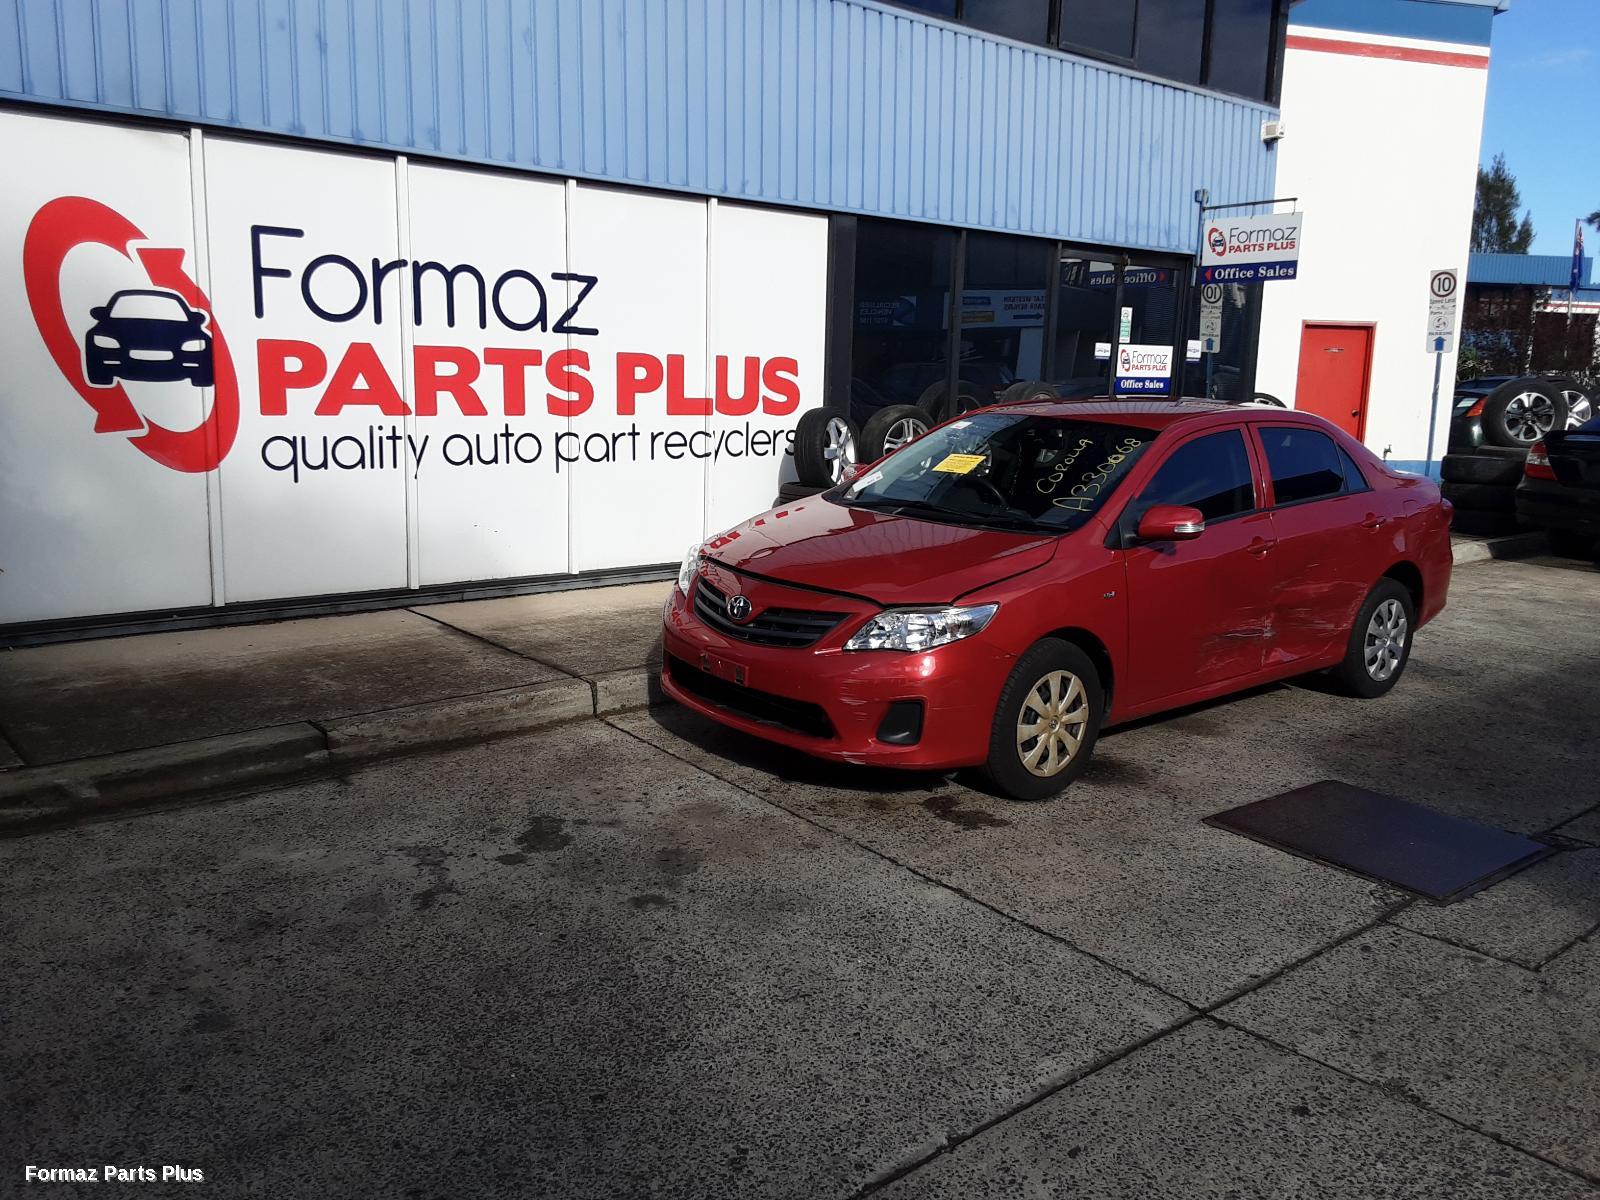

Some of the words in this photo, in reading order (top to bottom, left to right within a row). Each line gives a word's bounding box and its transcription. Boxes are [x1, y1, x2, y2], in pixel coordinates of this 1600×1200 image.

[1229, 227, 1297, 244] Formaz
[1228, 243, 1264, 253] PARTS
[1267, 241, 1296, 251] PLUS
[1215, 267, 1253, 279] Office
[1258, 265, 1294, 277] Sales
[251, 225, 599, 335] Formaz
[1437, 277, 1451, 292] 10
[1132, 351, 1168, 364] Formaz
[257, 339, 594, 416] PARTS
[616, 352, 800, 416] PLUS
[1121, 380, 1143, 389] Office
[1145, 380, 1164, 389] Sales
[262, 425, 429, 480] quality
[443, 424, 542, 466] auto
[555, 423, 640, 473] part
[651, 422, 795, 466] recyclers
